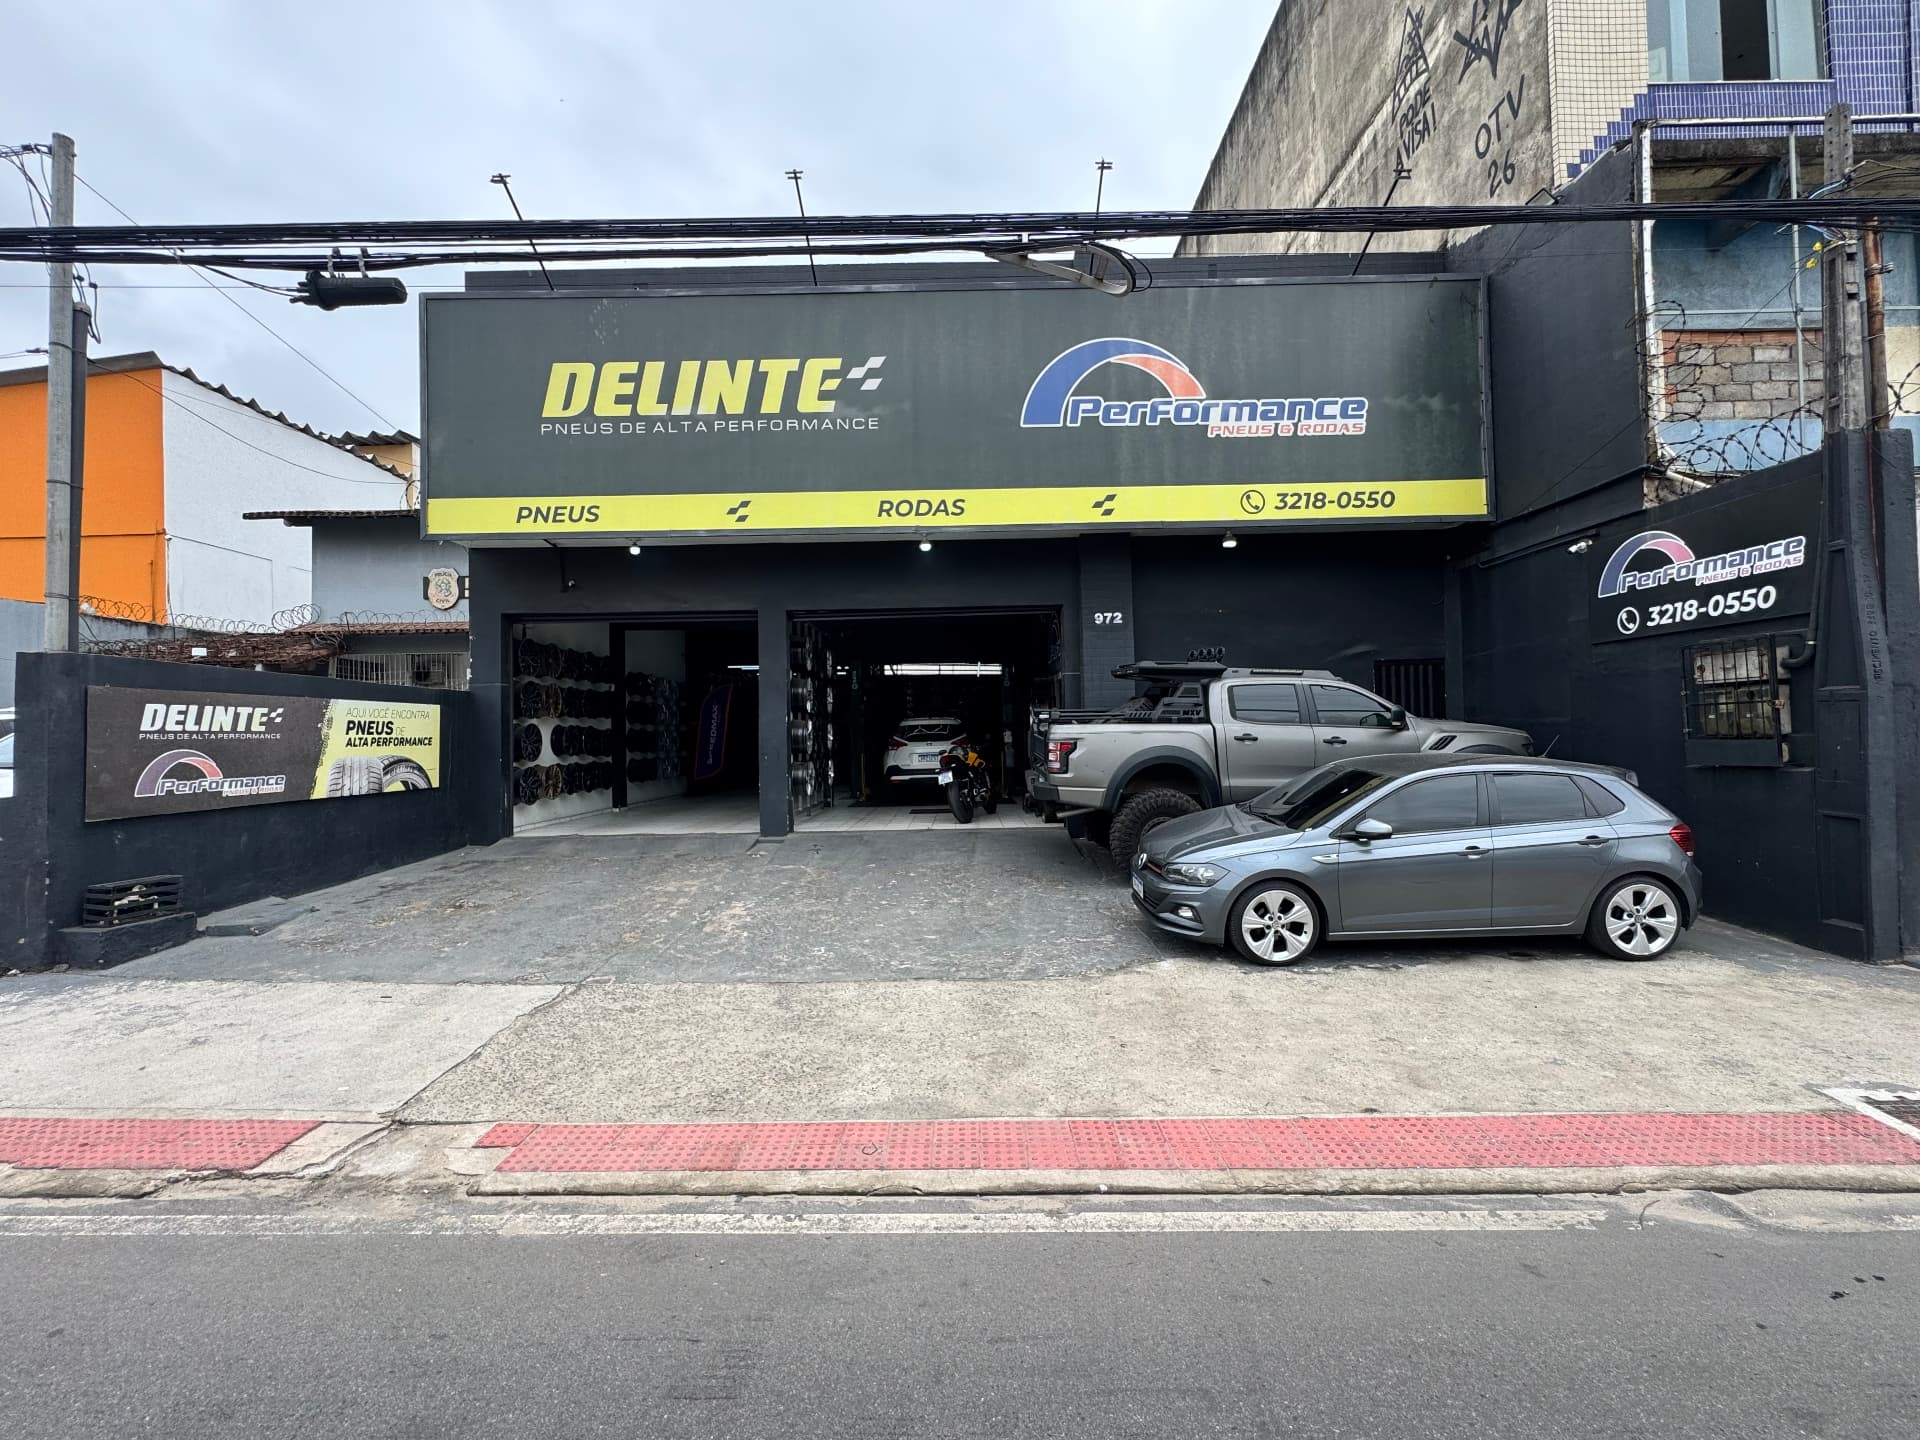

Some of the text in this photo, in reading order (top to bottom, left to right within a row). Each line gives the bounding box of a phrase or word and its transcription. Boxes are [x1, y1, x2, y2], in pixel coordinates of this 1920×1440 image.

[1488, 149, 1516, 198] 26
[541, 357, 843, 418] DELINTE
[1067, 396, 1368, 427] Performance
[541, 417, 880, 436] PNEUS DE ALTA PERFORMANCE
[1209, 424, 1273, 436] PNEUS
[1299, 422, 1365, 434] RODAS
[877, 499, 966, 518] RODAS
[1274, 491, 1396, 510] 3218-0550
[516, 505, 601, 524] PNEUS
[1619, 535, 1806, 593] Performance
[1696, 571, 1736, 586] PNEUS
[1754, 556, 1804, 574] RODAS
[1646, 585, 1777, 627] 3218-0550
[1094, 612, 1123, 624] 972
[140, 703, 269, 731] DELINTE
[346, 707, 430, 720] AQUI VOCÊ ENCONTRA
[345, 720, 406, 736] PNEUS DE
[345, 737, 433, 748] ALTA PERFORMANCE
[158, 775, 286, 796] Performance
